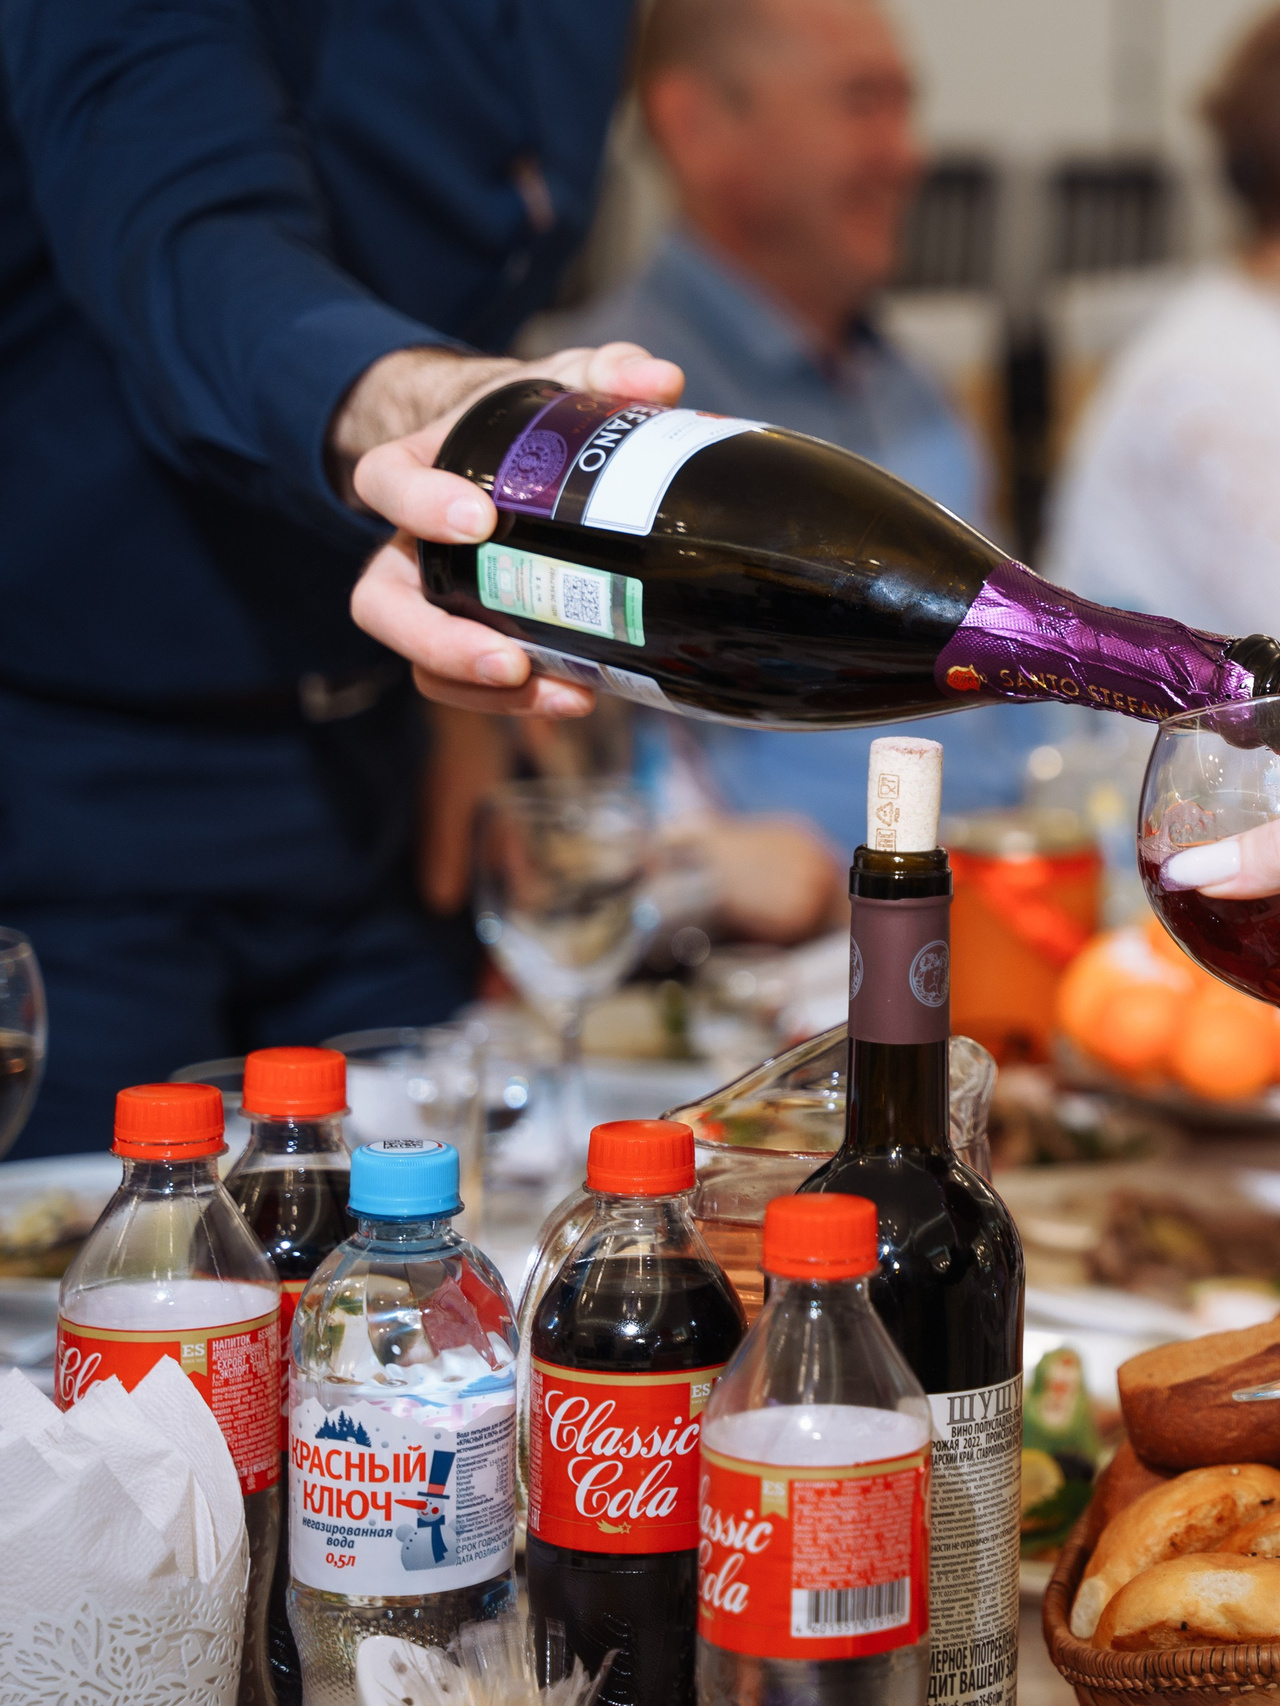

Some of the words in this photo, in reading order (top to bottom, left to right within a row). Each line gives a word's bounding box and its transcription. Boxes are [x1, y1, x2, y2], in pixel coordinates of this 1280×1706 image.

[1000, 668, 1080, 697] SANTO
[182, 1343, 205, 1357] ES
[212, 1334, 251, 1351] НАПИТОК
[691, 1382, 711, 1398] ES
[545, 1390, 700, 1459] Classic
[951, 1424, 973, 1438] ВИНО
[963, 1436, 983, 1449] 2022.
[291, 1434, 428, 1484] КРАСНЫЙ
[567, 1456, 679, 1519] Cola
[303, 1480, 393, 1522] КЛЮЧ
[302, 1516, 394, 1538] негазированная
[326, 1536, 355, 1549] вода
[456, 1542, 478, 1554] СРОК
[325, 1551, 357, 1569] 0,5л
[456, 1555, 473, 1565] ДАТА
[959, 1658, 1006, 1695] ВАШЕМУ
